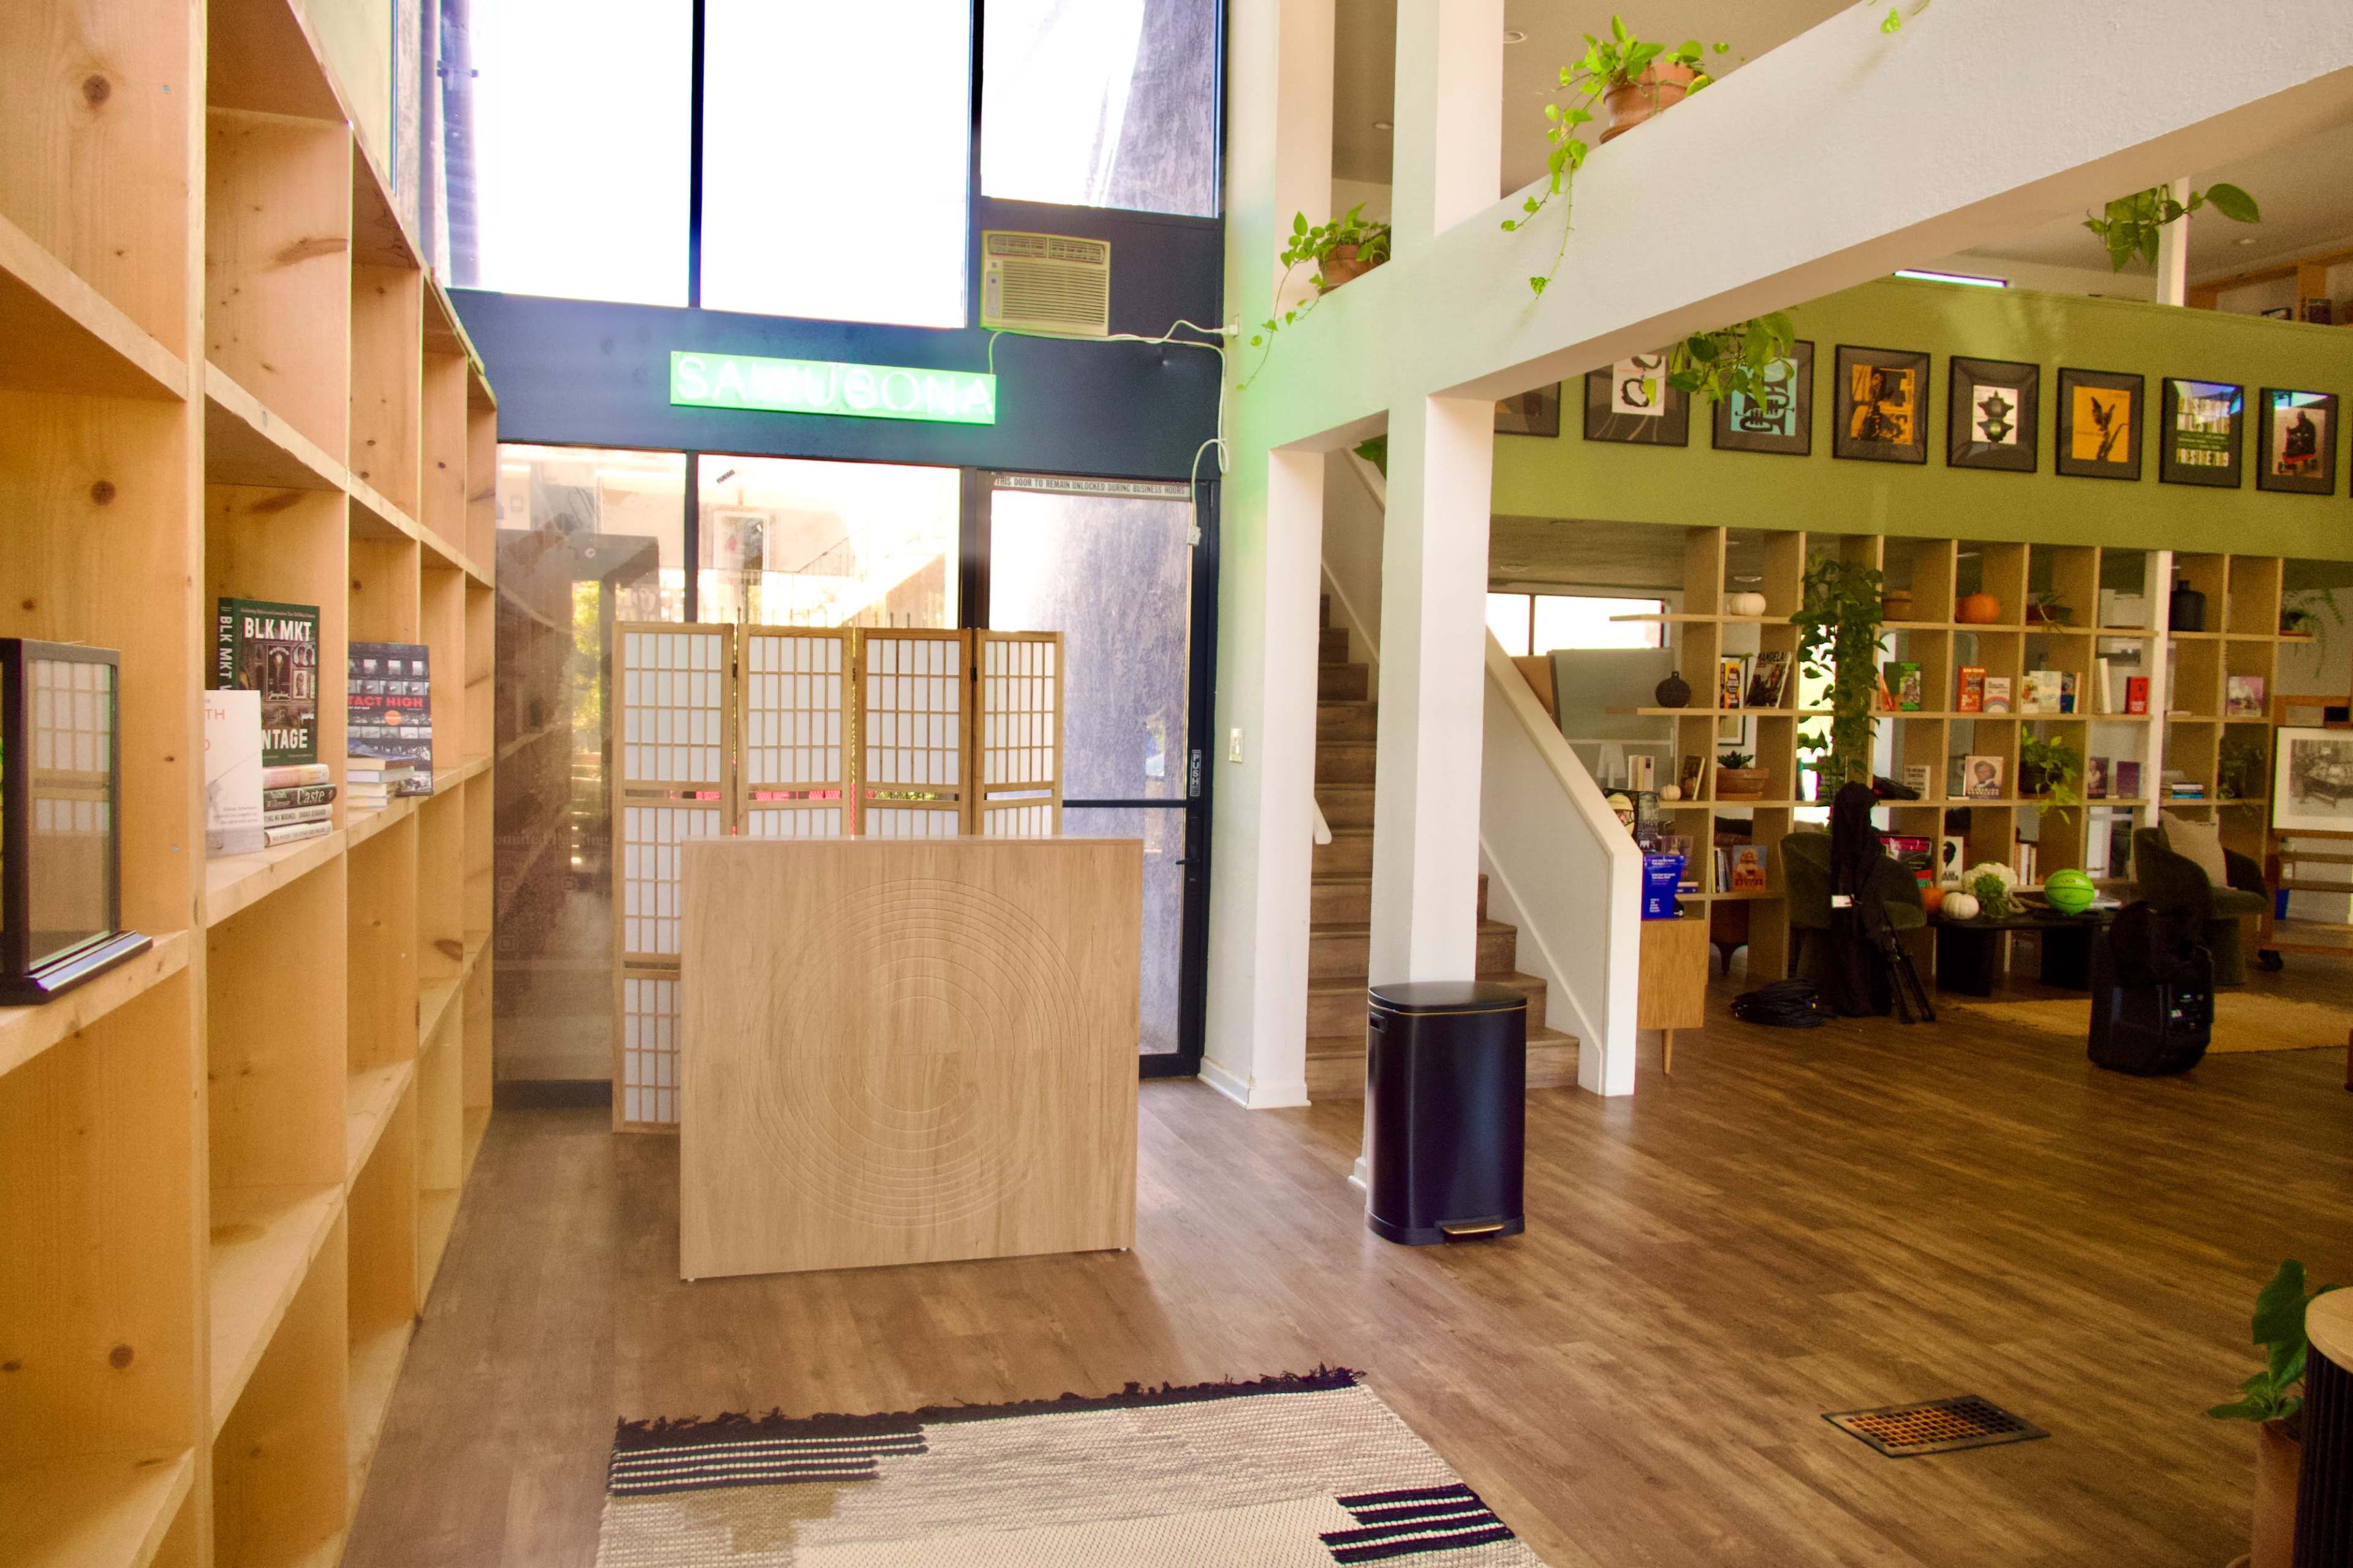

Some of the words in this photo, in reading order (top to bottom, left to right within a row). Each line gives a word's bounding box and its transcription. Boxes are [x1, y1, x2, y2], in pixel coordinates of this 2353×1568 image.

[996, 477, 1011, 485] THIS
[1014, 478, 1032, 487] DOOR
[1046, 480, 1070, 488] REMAIN
[1072, 481, 1105, 491] UNLOCKED
[1107, 483, 1131, 492] DURING
[1133, 485, 1162, 494] BUSINESS
[1165, 486, 1185, 494] HOURS
[219, 616, 233, 642] BLK
[243, 617, 275, 639] BLK
[280, 619, 313, 642] MKT
[219, 648, 233, 679] MKT
[386, 697, 423, 708] HIGH
[297, 788, 325, 804] Caste
